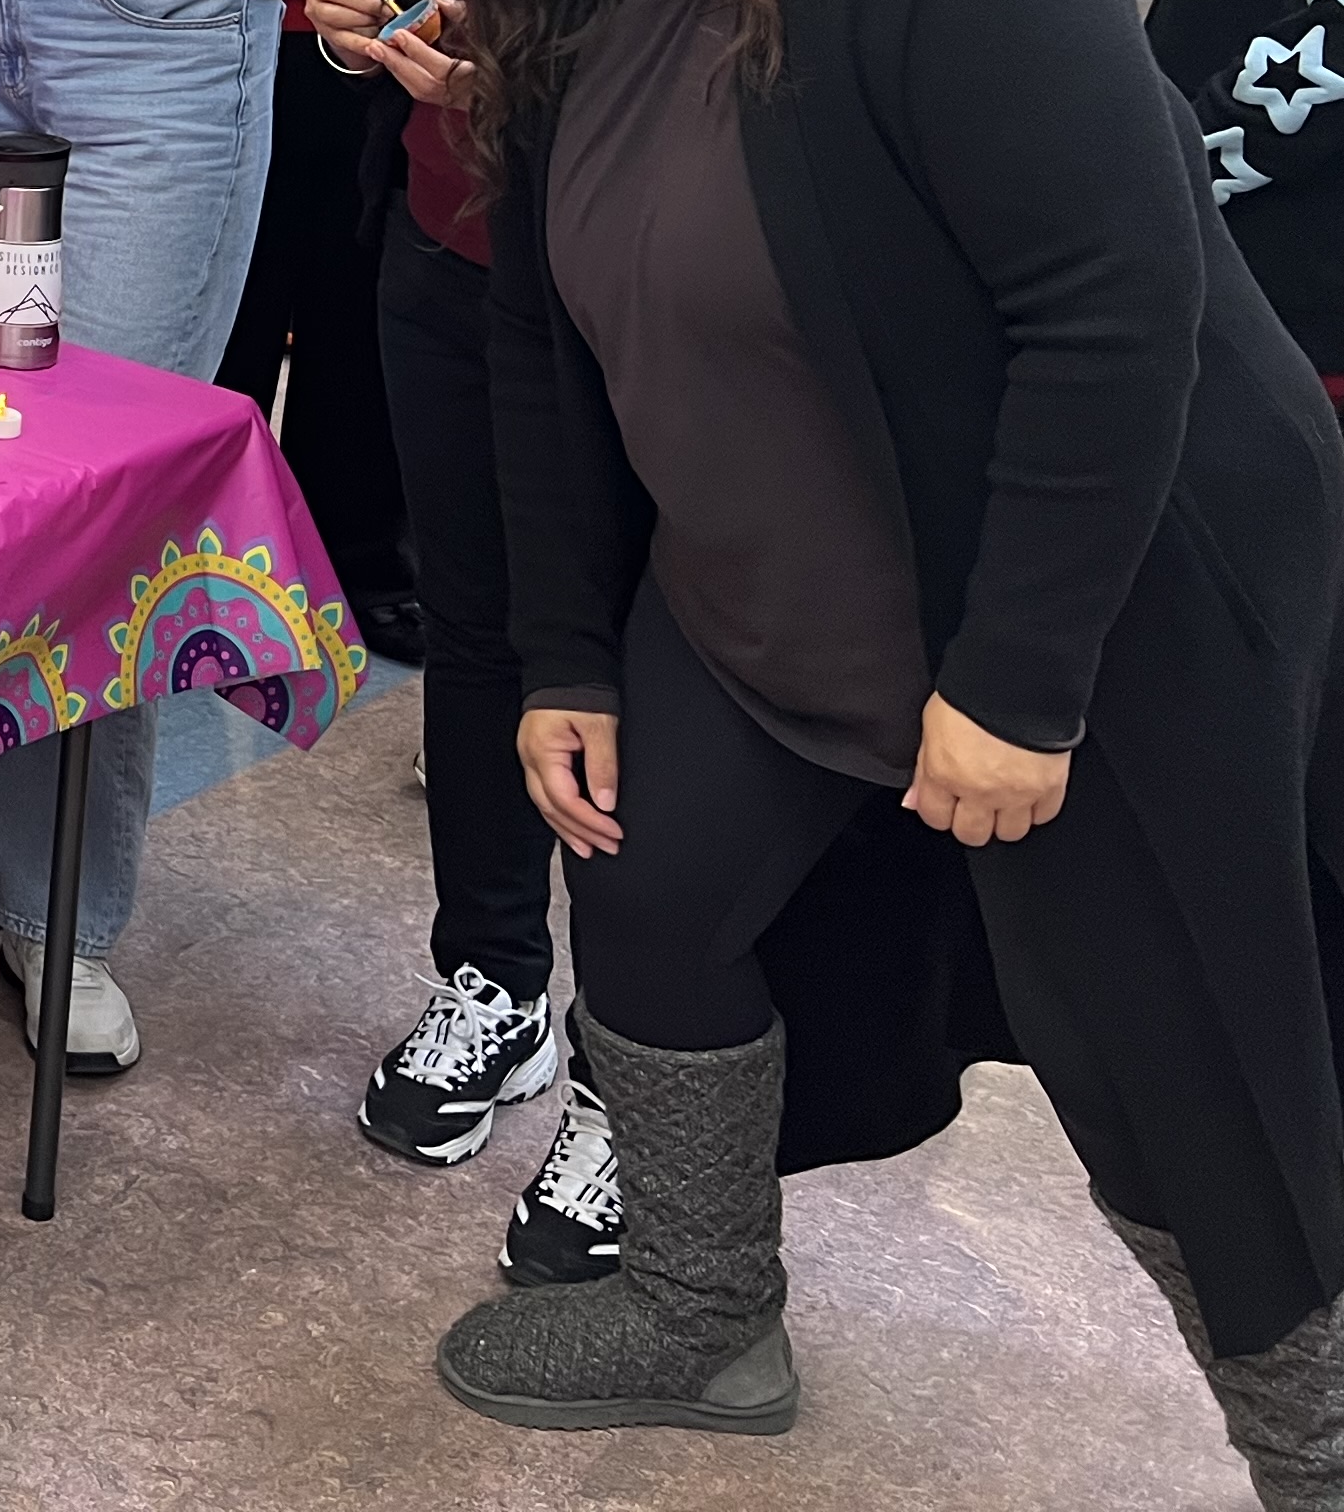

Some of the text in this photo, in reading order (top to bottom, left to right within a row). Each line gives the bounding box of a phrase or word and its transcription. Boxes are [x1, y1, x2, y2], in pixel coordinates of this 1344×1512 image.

[0, 251, 31, 264] STILL
[6, 265, 46, 276] DESIGN
[17, 337, 53, 349] contigo
